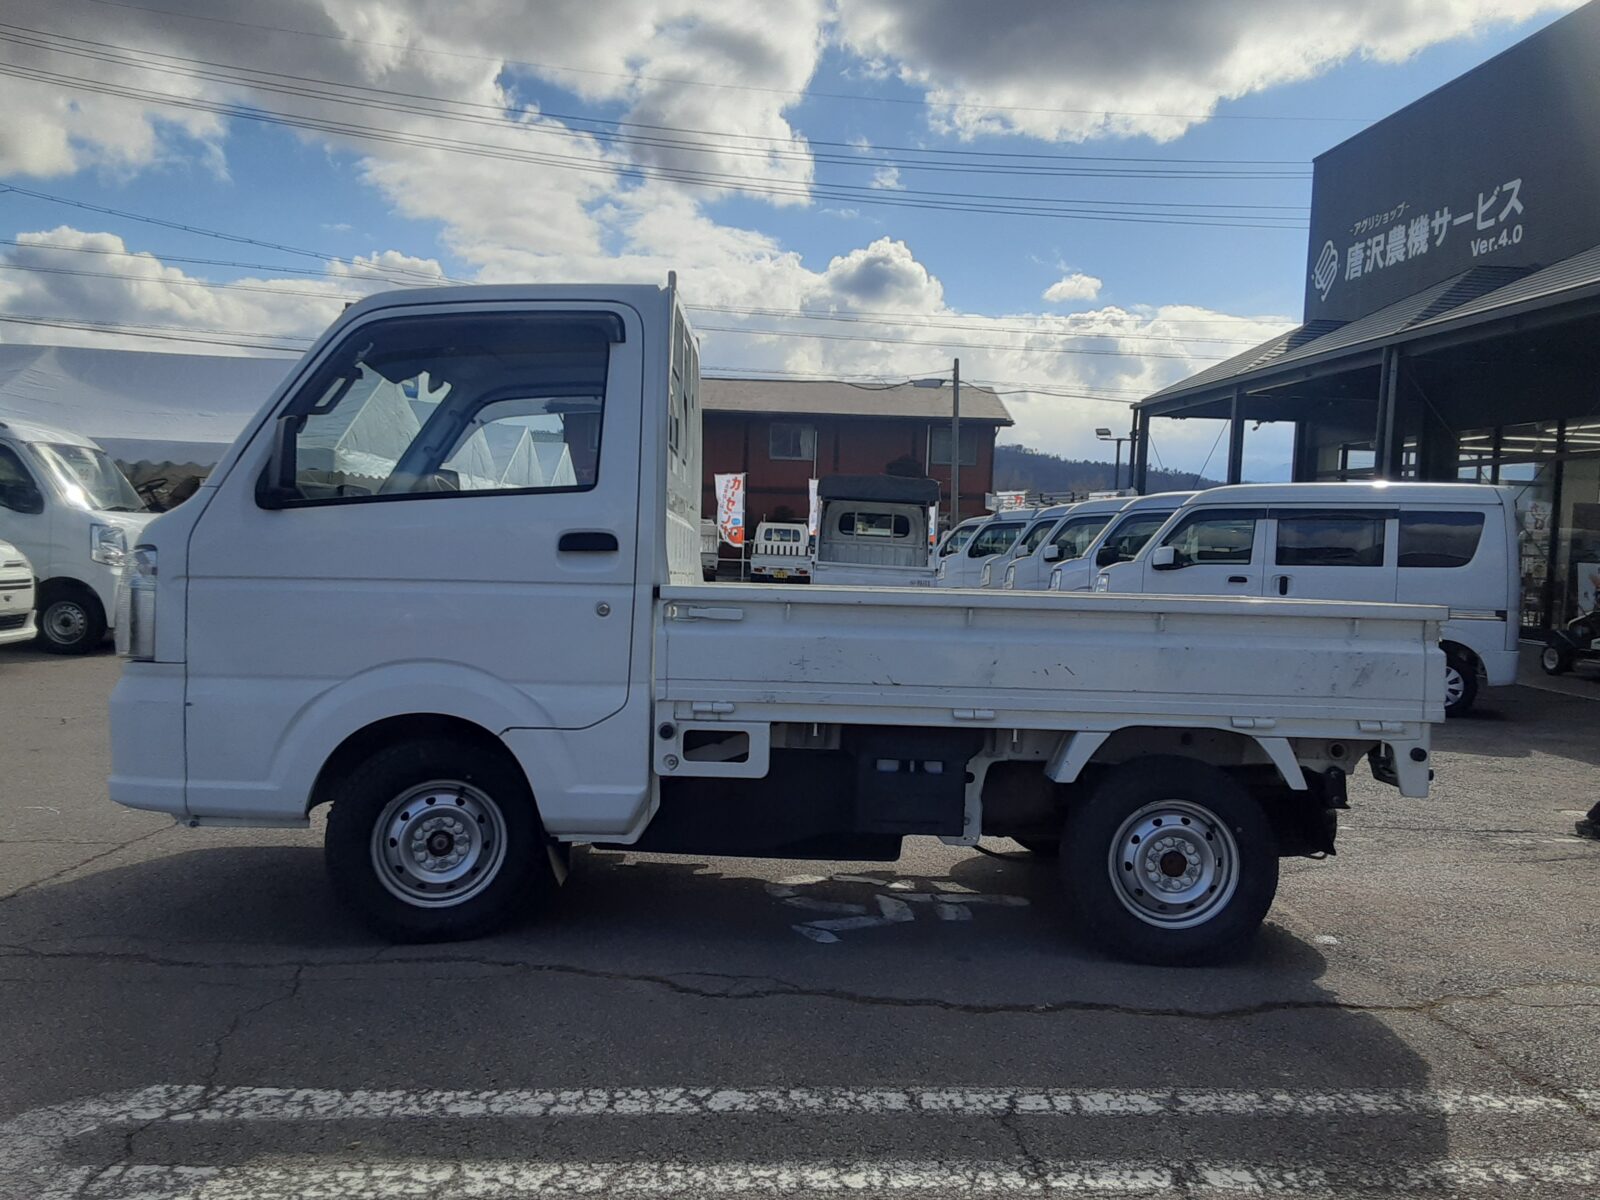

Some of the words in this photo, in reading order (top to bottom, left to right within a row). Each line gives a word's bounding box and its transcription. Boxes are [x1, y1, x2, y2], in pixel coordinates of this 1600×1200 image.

[1344, 178, 1524, 282] 唐沢農機サービス
[1471, 224, 1523, 257] Ver.4.0
